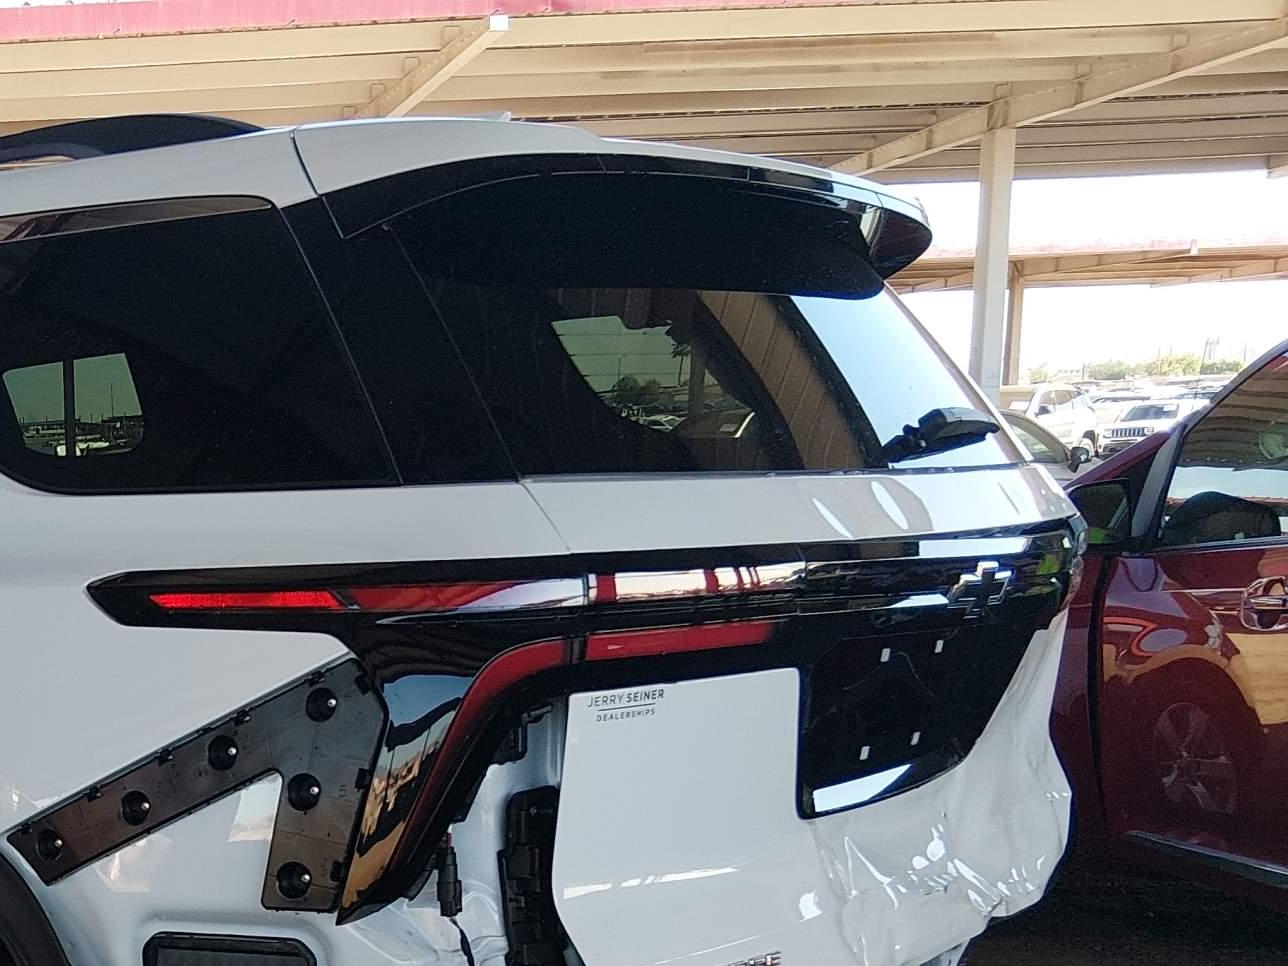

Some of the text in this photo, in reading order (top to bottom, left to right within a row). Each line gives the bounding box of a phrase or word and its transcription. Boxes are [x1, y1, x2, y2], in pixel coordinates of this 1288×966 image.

[587, 689, 665, 707] JERRY SEINER
[596, 708, 656, 721] DEALERSHIPS
